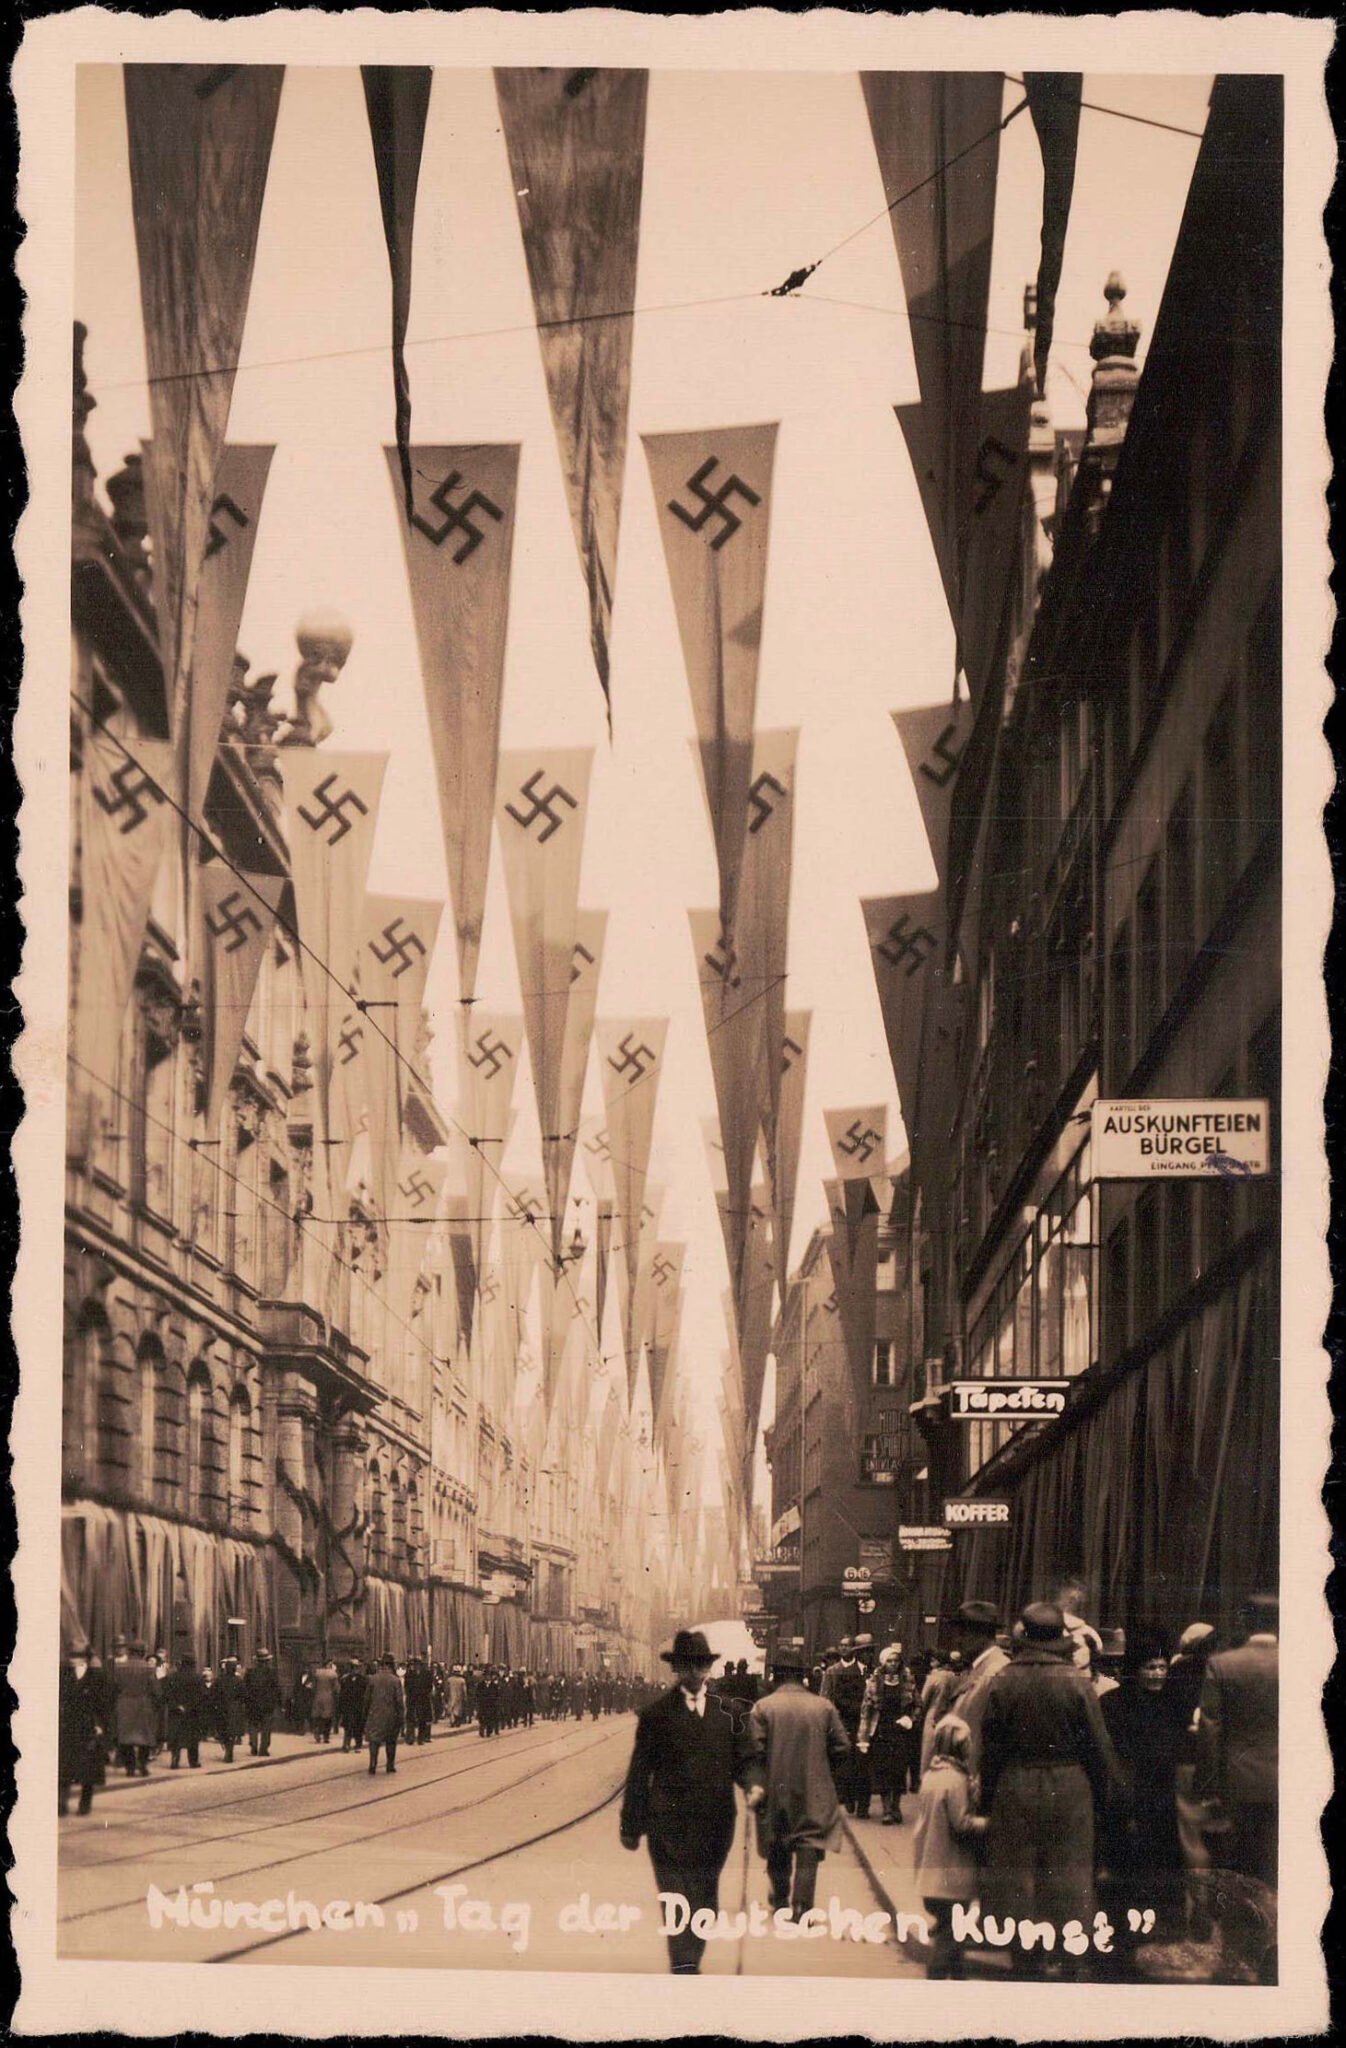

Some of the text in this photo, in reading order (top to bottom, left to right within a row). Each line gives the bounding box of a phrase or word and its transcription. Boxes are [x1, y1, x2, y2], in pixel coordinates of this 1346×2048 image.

[1103, 1114, 1261, 1134] AUSKUNFTEIEN
[1140, 1133, 1227, 1155] BÜRGEL
[1151, 1161, 1197, 1171] EINGANG
[954, 1386, 1066, 1413] Tapeten
[945, 1503, 1010, 1522] KOFFER
